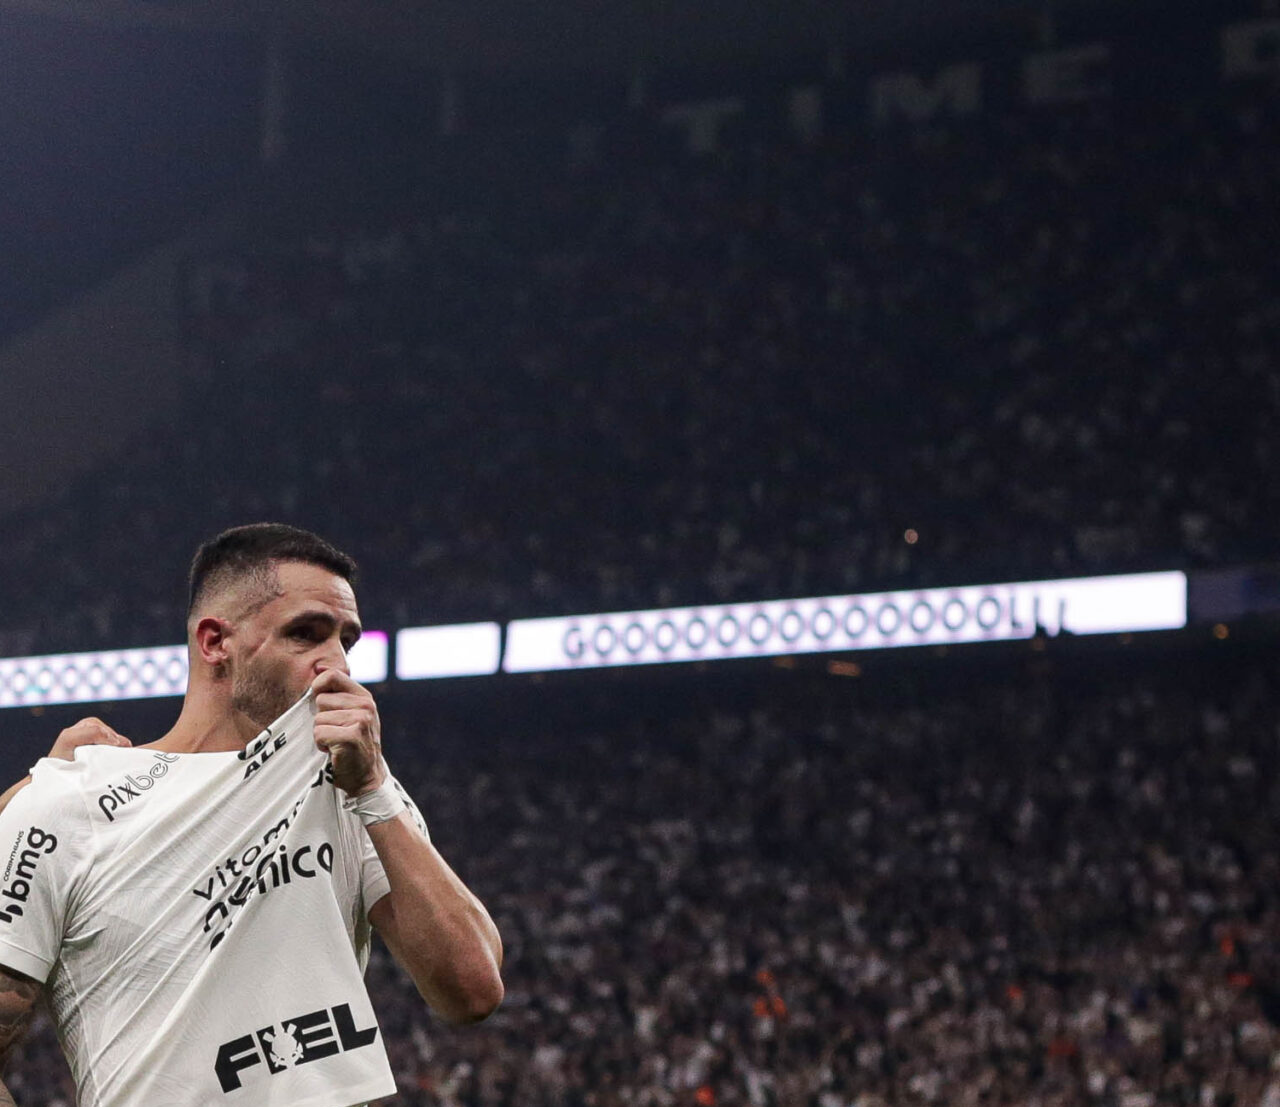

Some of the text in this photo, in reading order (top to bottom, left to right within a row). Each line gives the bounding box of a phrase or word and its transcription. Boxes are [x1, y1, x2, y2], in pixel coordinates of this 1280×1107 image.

[243, 732, 288, 780] ALE
[98, 752, 181, 822] pixbet
[2, 826, 58, 902] bmg
[3, 830, 25, 882] CORINTHIANS
